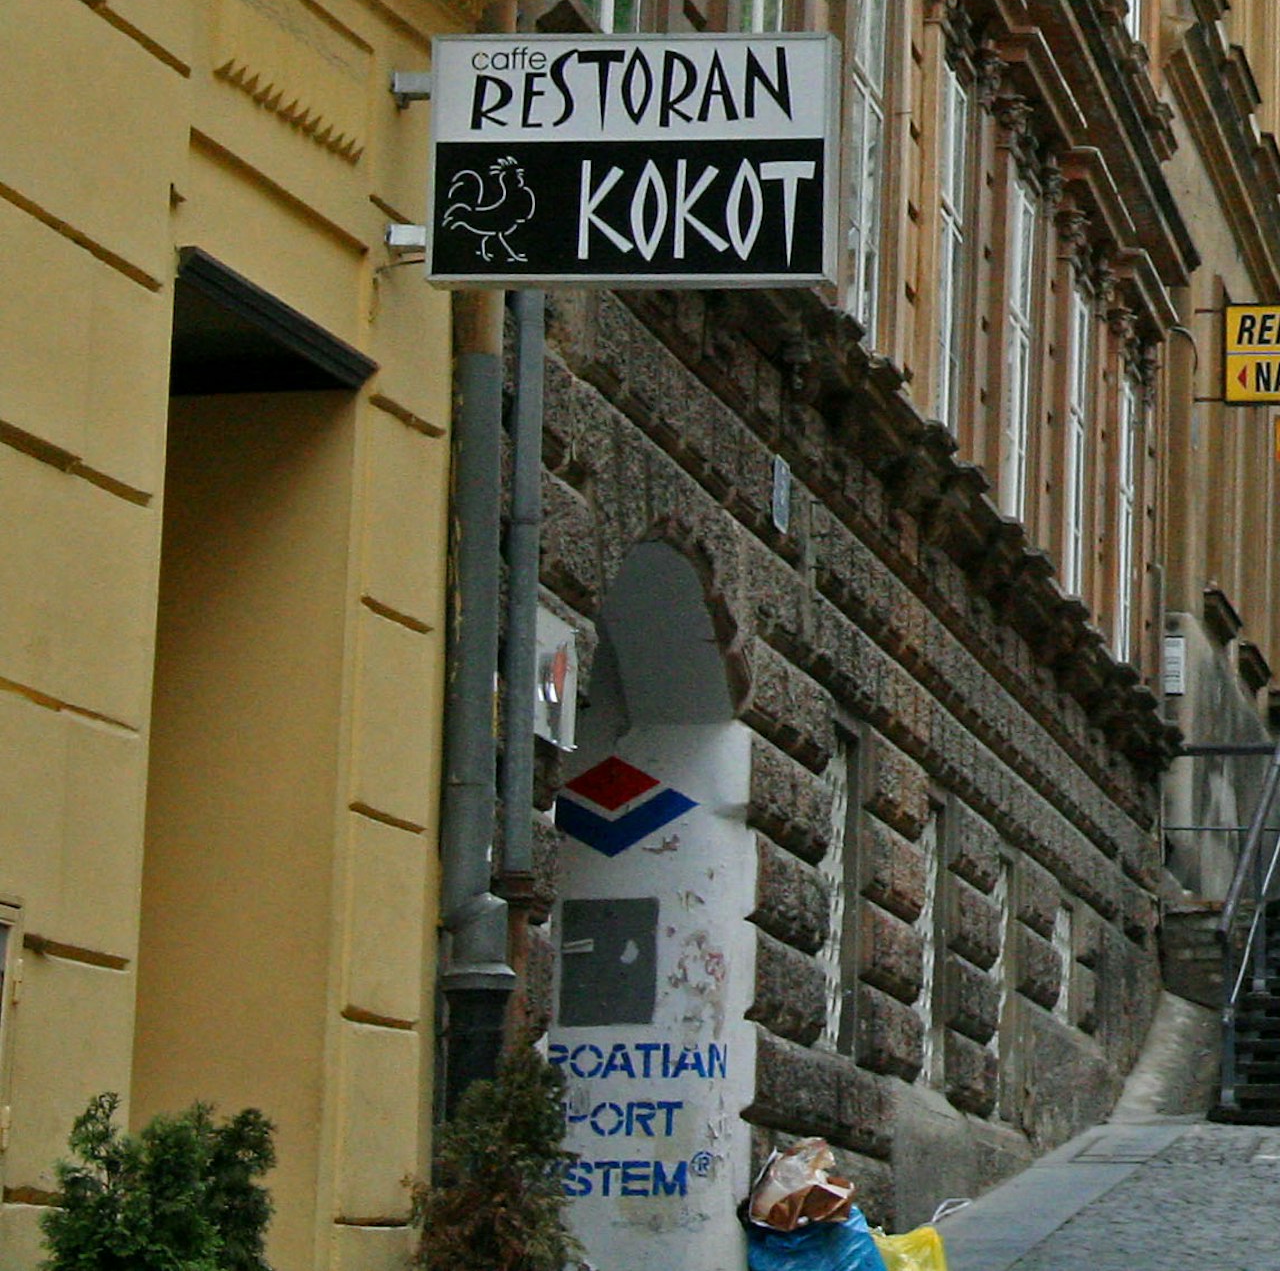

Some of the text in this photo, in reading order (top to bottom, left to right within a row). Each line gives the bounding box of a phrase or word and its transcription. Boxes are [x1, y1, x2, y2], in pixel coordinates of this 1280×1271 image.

[470, 46, 792, 130] RESTORAN
[471, 46, 547, 71] caffe
[577, 157, 816, 268] KOKOT
